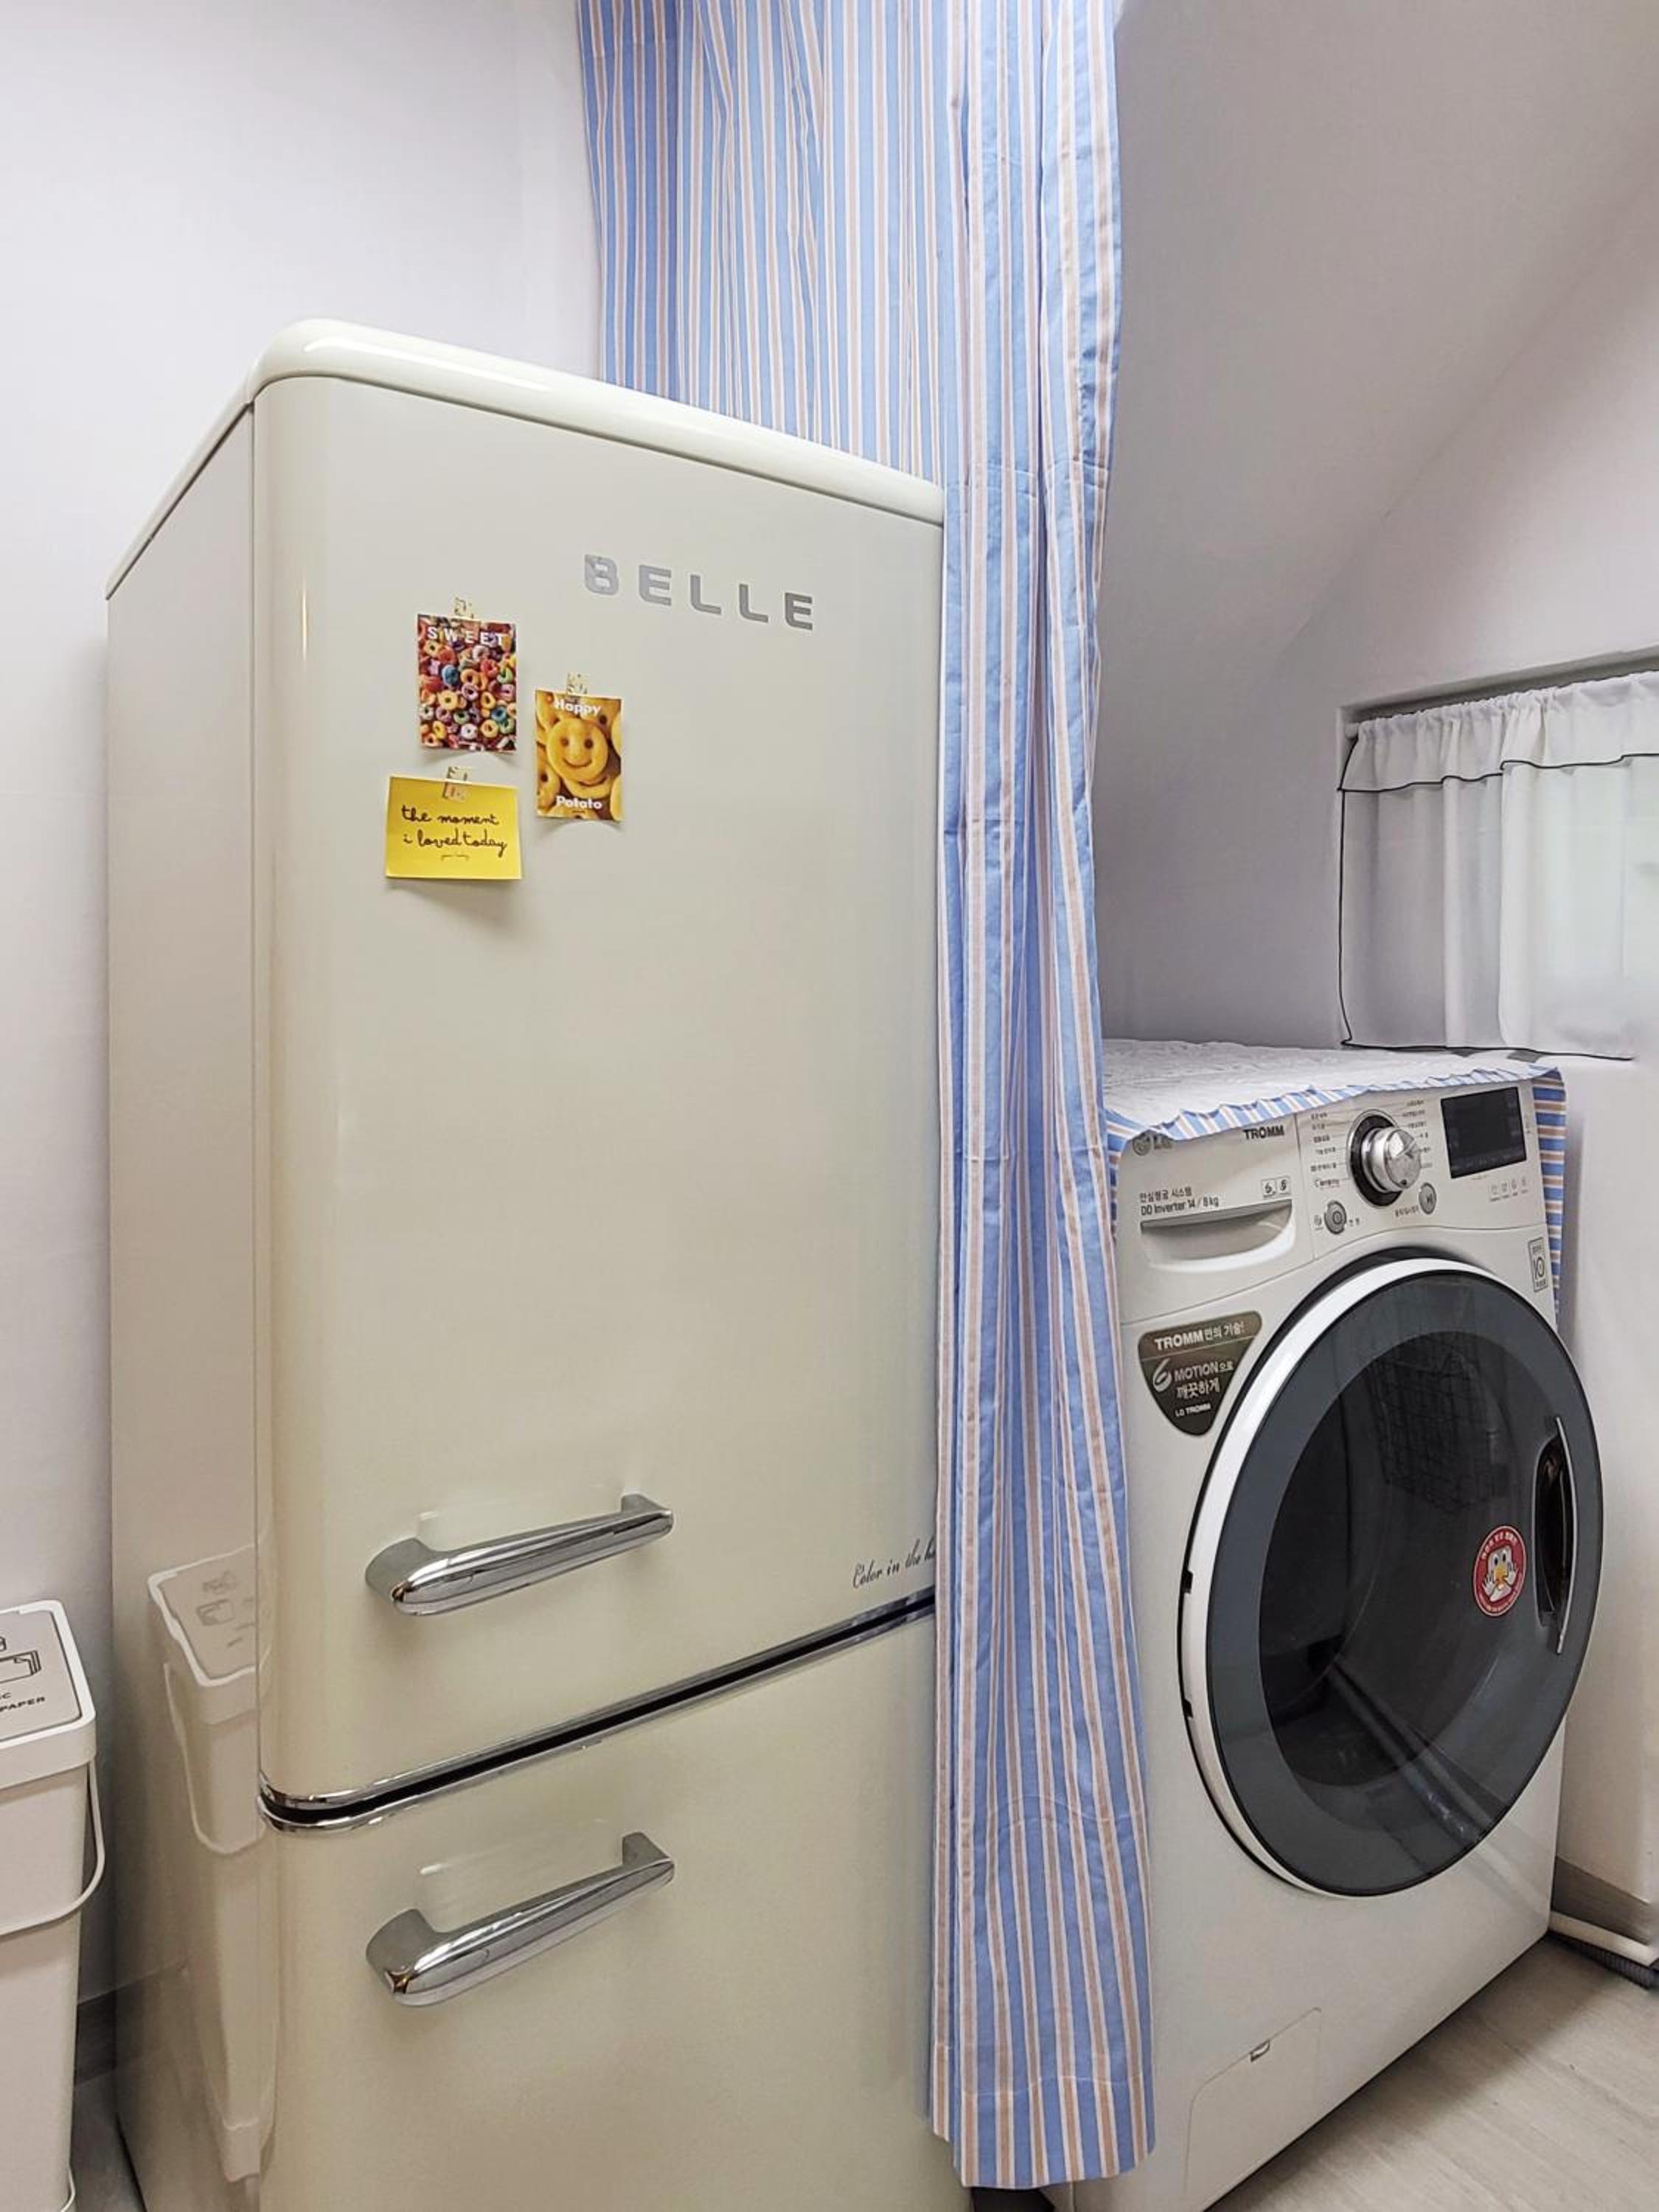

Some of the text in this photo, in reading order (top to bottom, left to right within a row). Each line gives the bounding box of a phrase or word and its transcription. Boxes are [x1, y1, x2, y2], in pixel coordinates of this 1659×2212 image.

[584, 553, 813, 631] BELLE
[427, 626, 508, 647] SWEET
[554, 699, 602, 717] Happy
[556, 795, 603, 810] Potato
[401, 804, 499, 825] the moment
[1243, 1124, 1285, 1141] TROMM
[1154, 1202, 1186, 1214] Inverter
[1185, 1402, 1211, 1415] TROMM
[853, 1559, 883, 1588] Color
[887, 1559, 900, 1576] in
[905, 1538, 921, 1568] the
